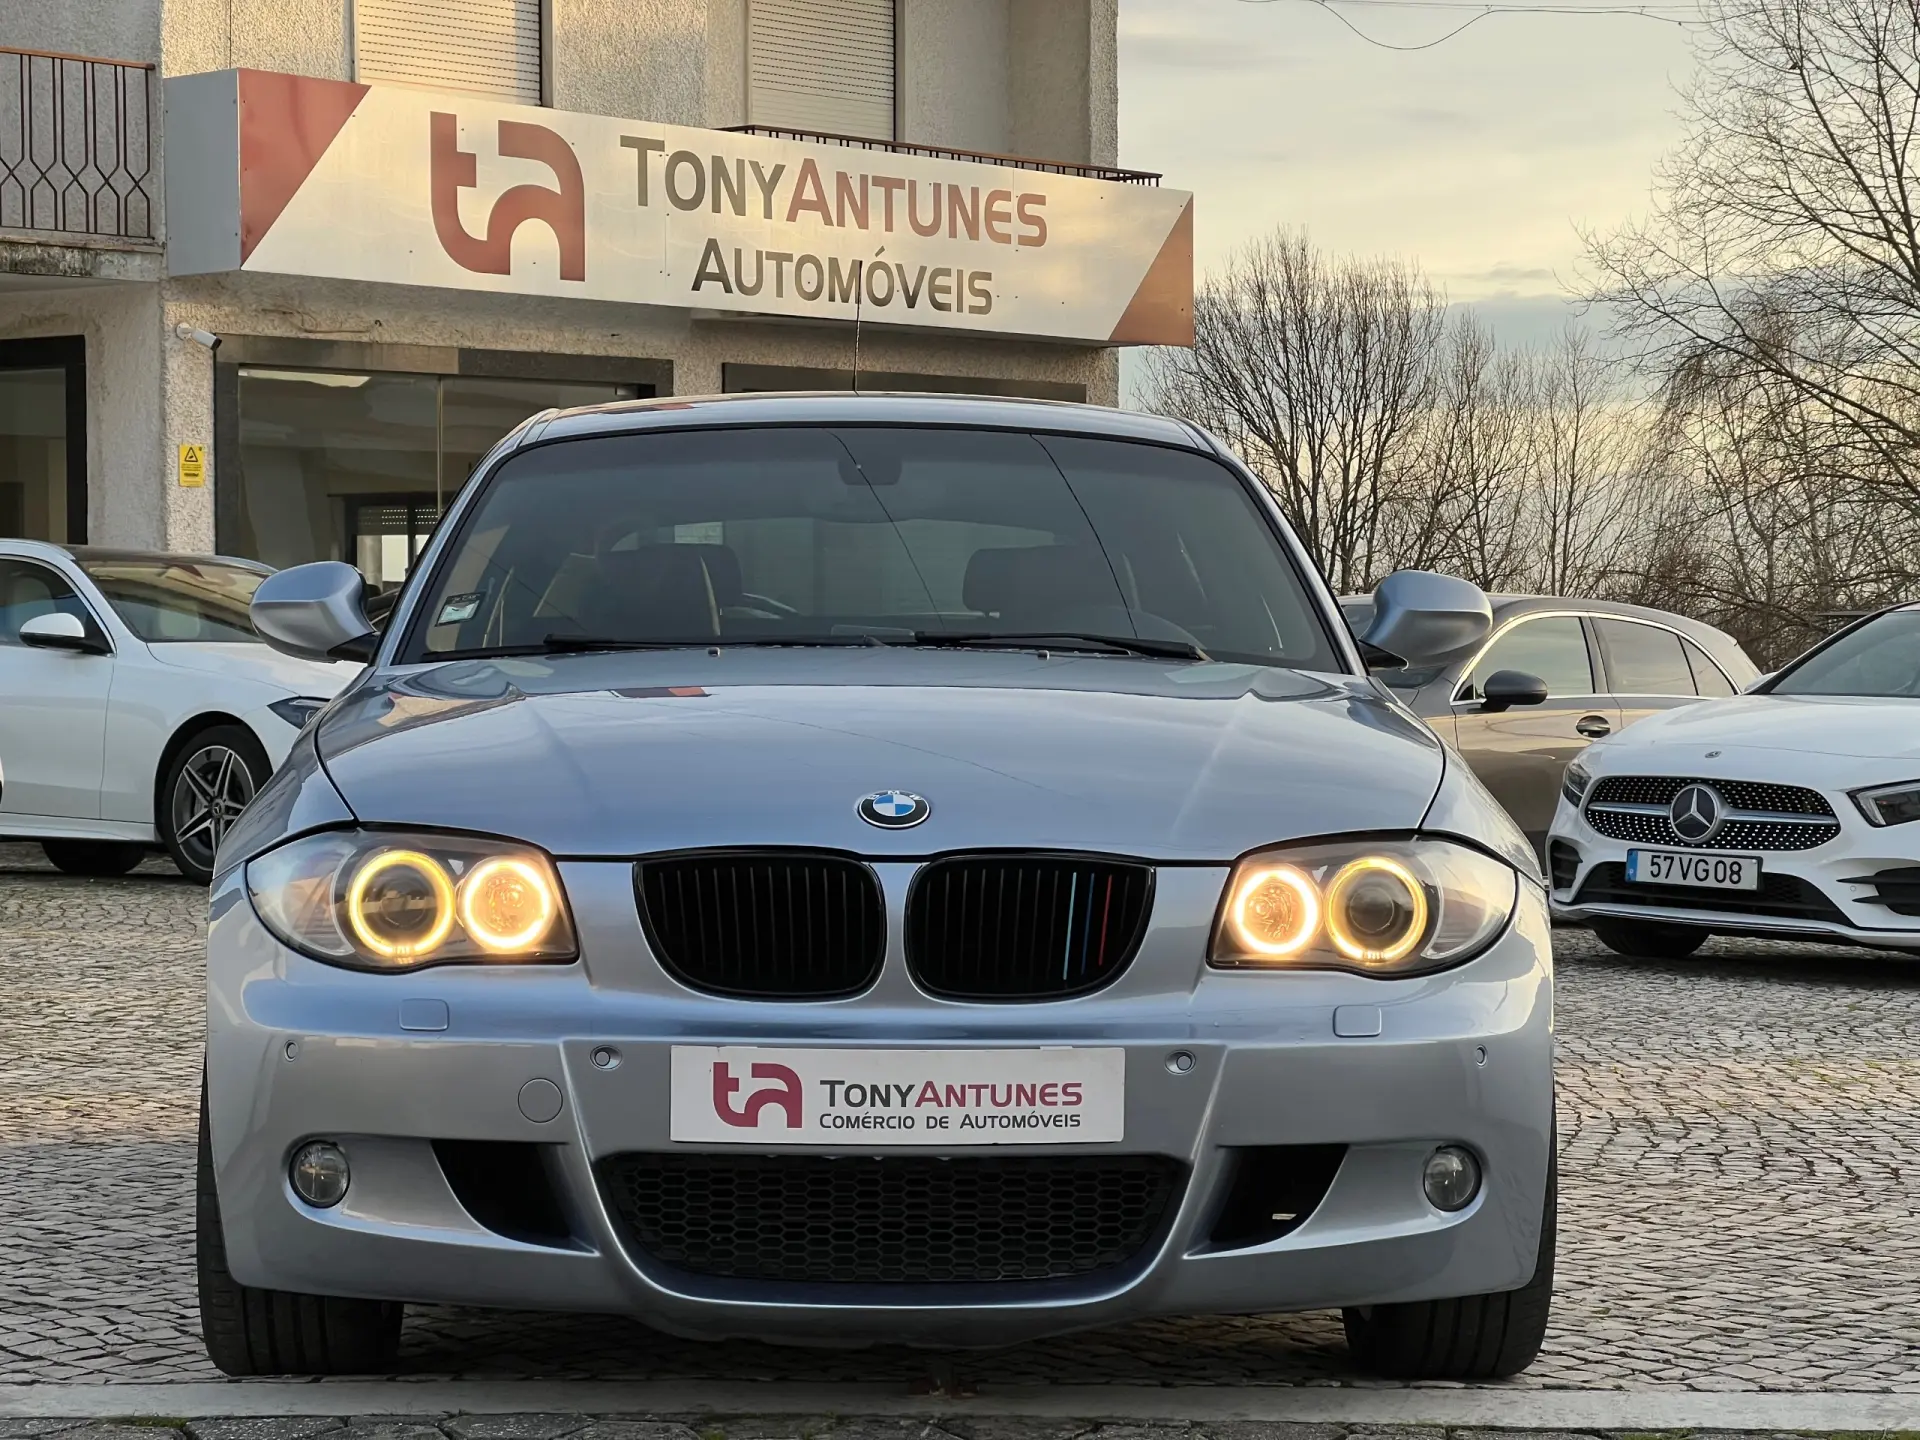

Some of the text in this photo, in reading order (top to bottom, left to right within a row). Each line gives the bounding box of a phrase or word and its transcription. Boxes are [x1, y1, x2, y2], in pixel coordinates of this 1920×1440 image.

[691, 238, 993, 316] AUTOMÓVEIS
[819, 1110, 1081, 1130] COMÉRCIO DE AUTOMÓVEIS
